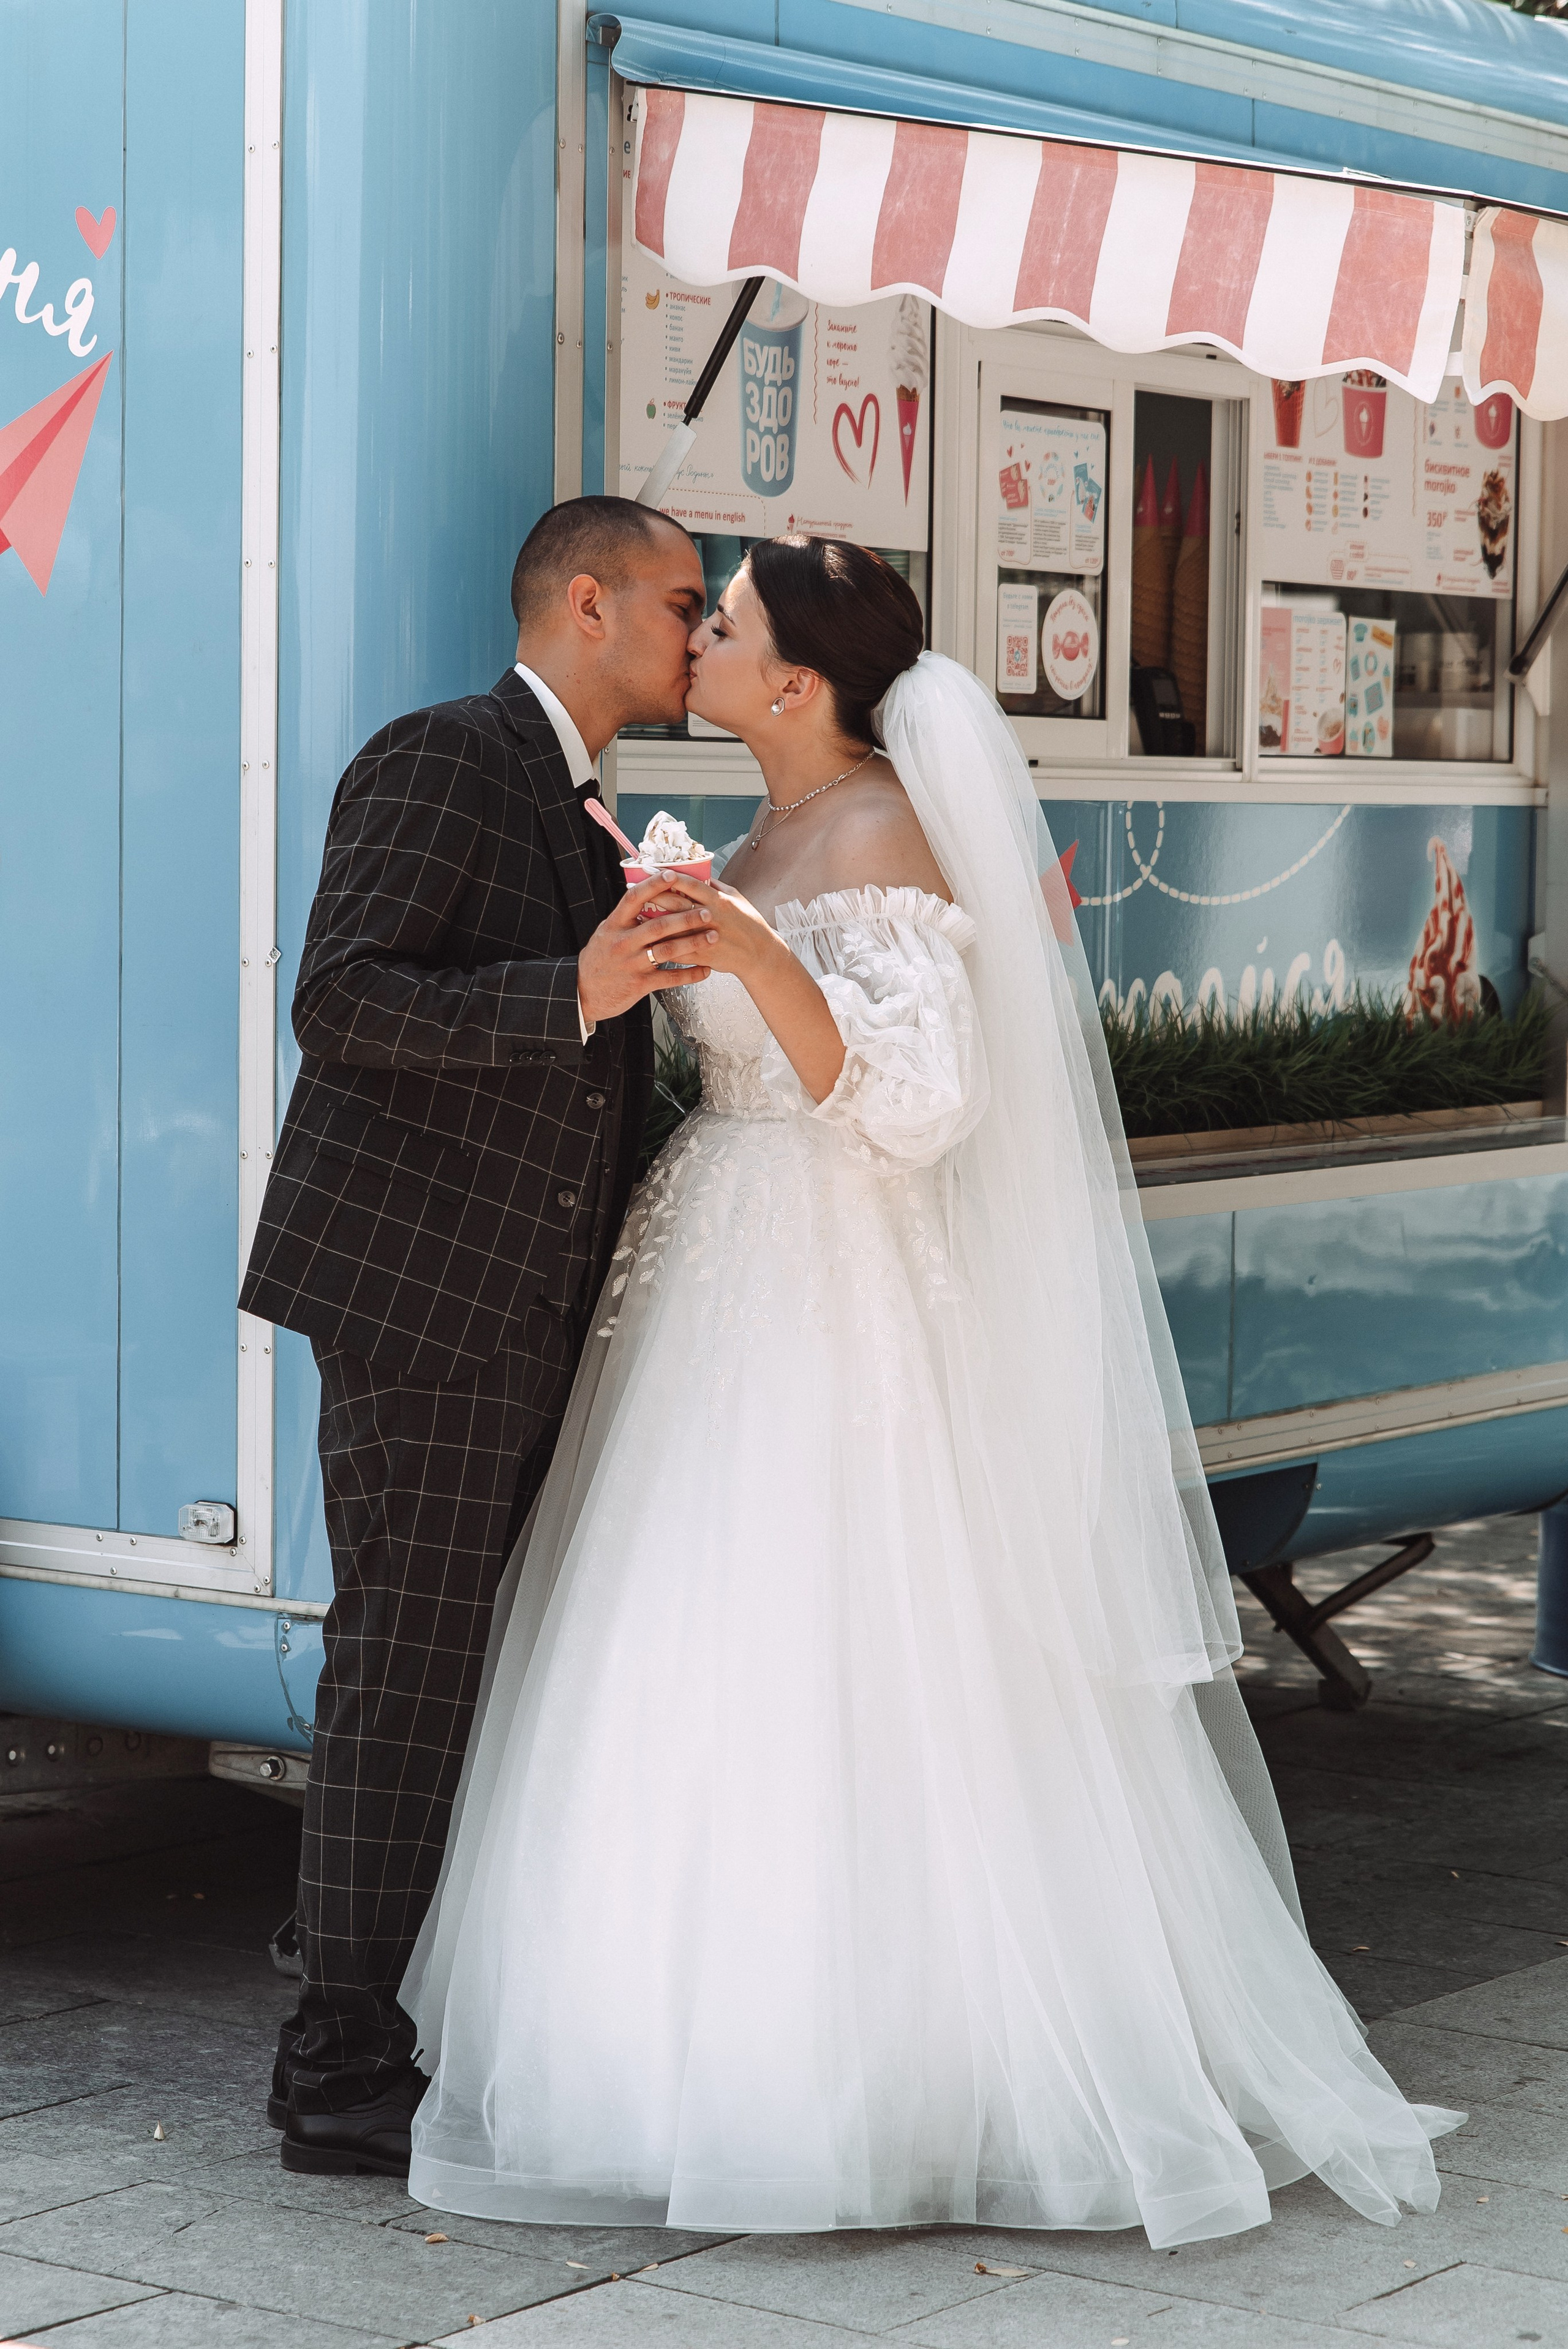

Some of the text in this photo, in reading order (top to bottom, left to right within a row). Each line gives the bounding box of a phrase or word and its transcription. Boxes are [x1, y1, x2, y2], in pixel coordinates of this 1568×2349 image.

[669, 292, 711, 306] ТРОПИЧЕСКИЕ
[827, 319, 858, 334] Закажите
[669, 357, 693, 365] мандарин
[743, 337, 795, 387] БУДЬ
[826, 358, 839, 369] кофе
[669, 367, 692, 376] маракуйя
[826, 373, 861, 391] это вкусно!
[745, 381, 793, 434] ЗДО
[746, 428, 790, 483] РОВ
[1425, 459, 1470, 478] бисквитное
[671, 506, 687, 518] have
[694, 510, 713, 520] menu
[715, 510, 721, 521] in
[723, 512, 745, 524] english
